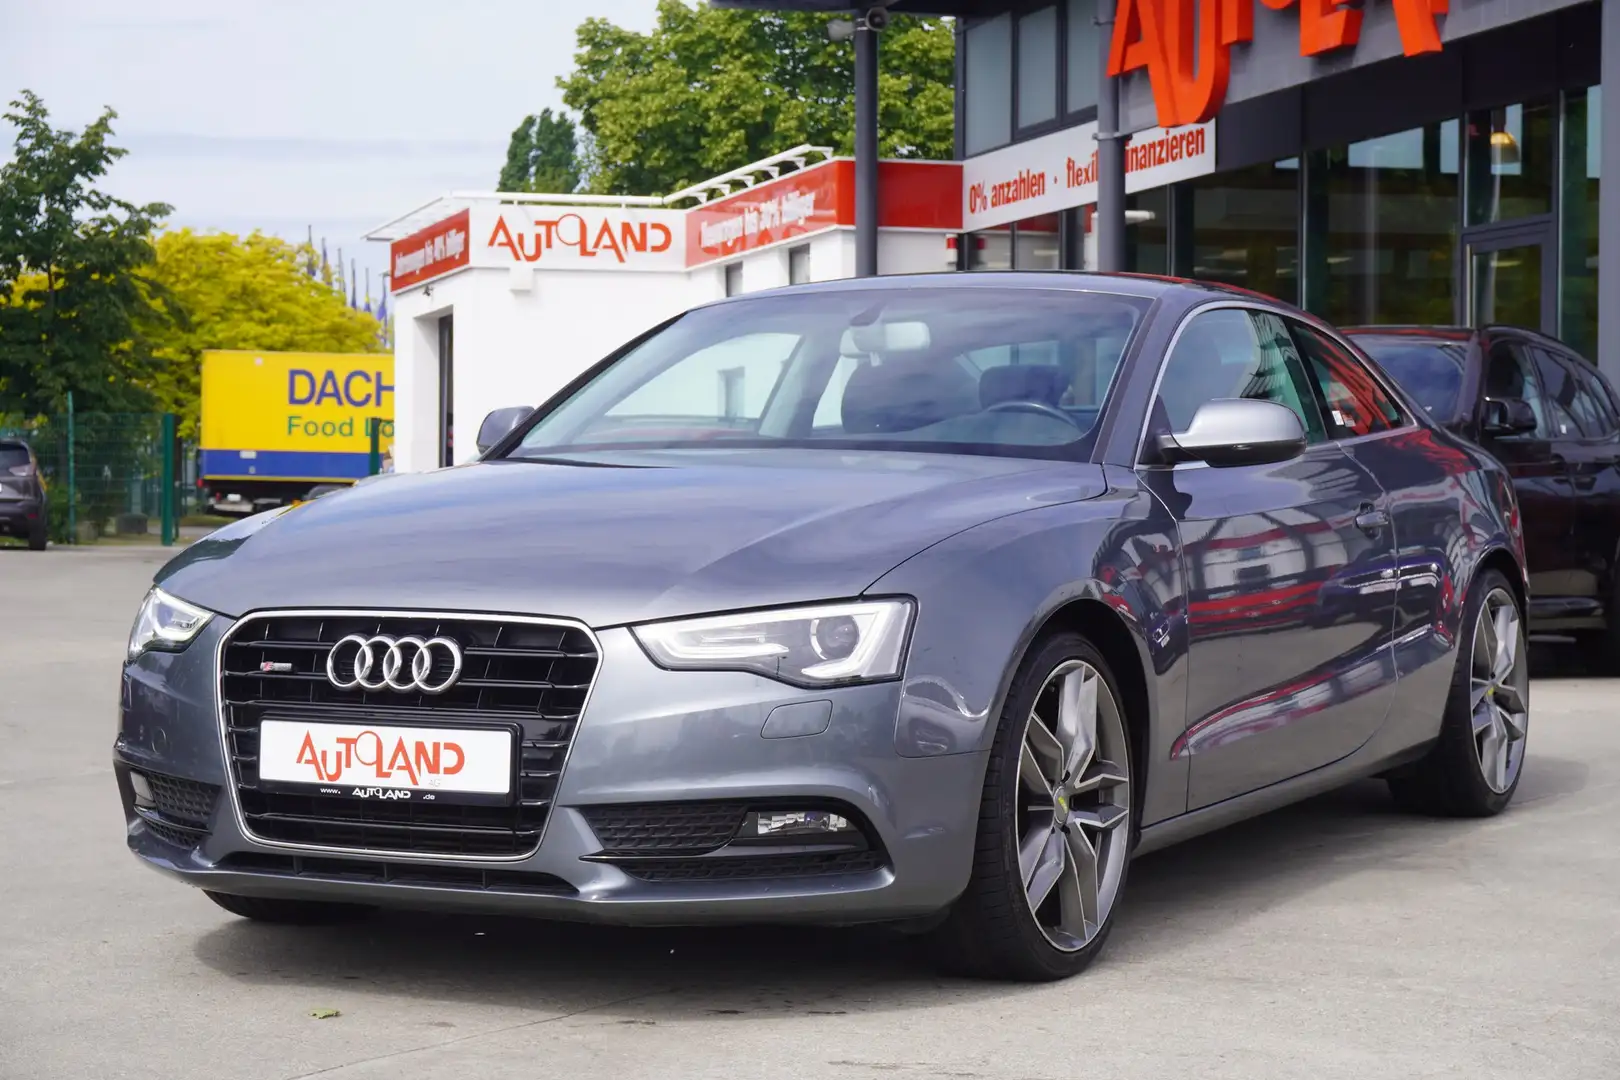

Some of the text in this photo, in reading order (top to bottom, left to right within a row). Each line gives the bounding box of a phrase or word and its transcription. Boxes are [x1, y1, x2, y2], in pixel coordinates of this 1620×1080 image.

[969, 185, 988, 213] 0%
[991, 169, 1045, 206] anzahlen
[1125, 127, 1205, 173] inanzieren
[287, 415, 353, 437] Food
[320, 787, 341, 795] www.
